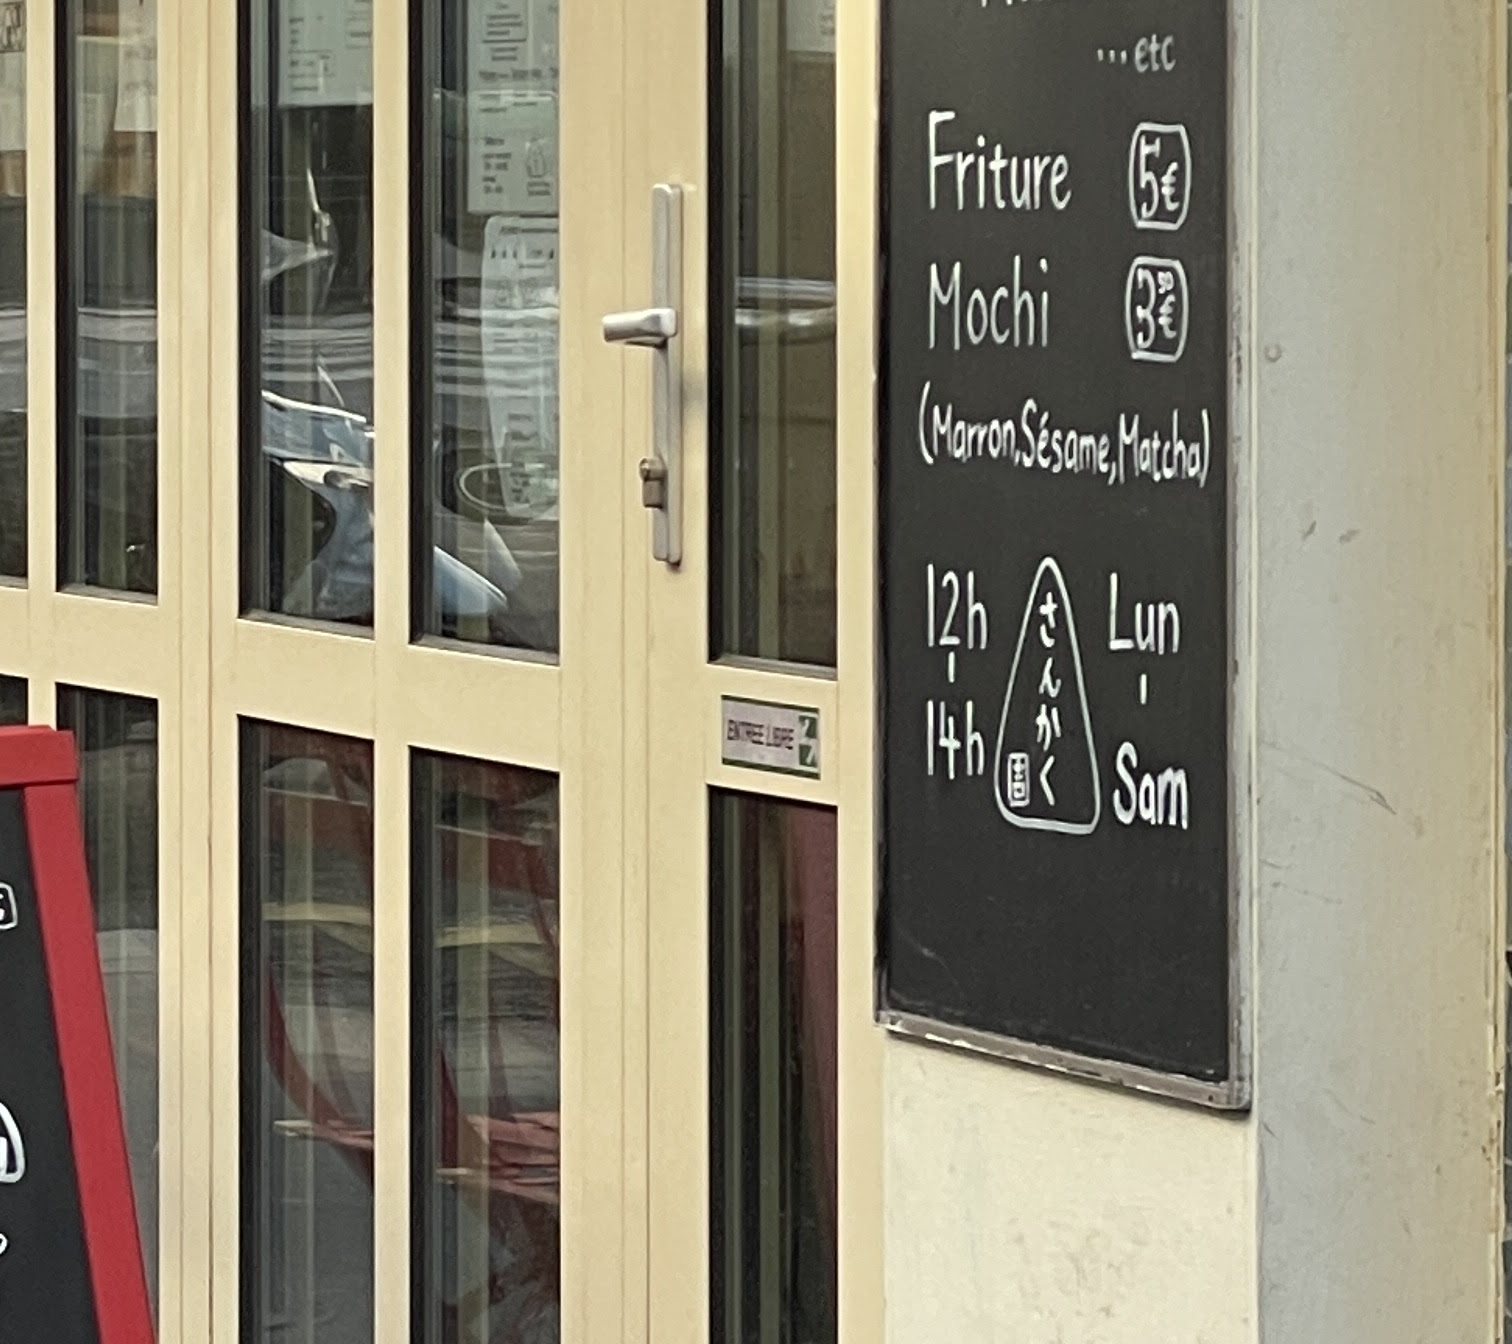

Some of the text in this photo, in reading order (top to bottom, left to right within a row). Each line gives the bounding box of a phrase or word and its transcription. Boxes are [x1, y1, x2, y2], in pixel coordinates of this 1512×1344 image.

[929, 110, 1072, 210] Friture
[1139, 136, 1180, 219] 5€
[929, 255, 1049, 350] Mochi
[928, 563, 987, 650] 12h
[1109, 572, 1181, 654] Lun
[928, 700, 985, 780] 14h
[1113, 741, 1188, 830] Sam
